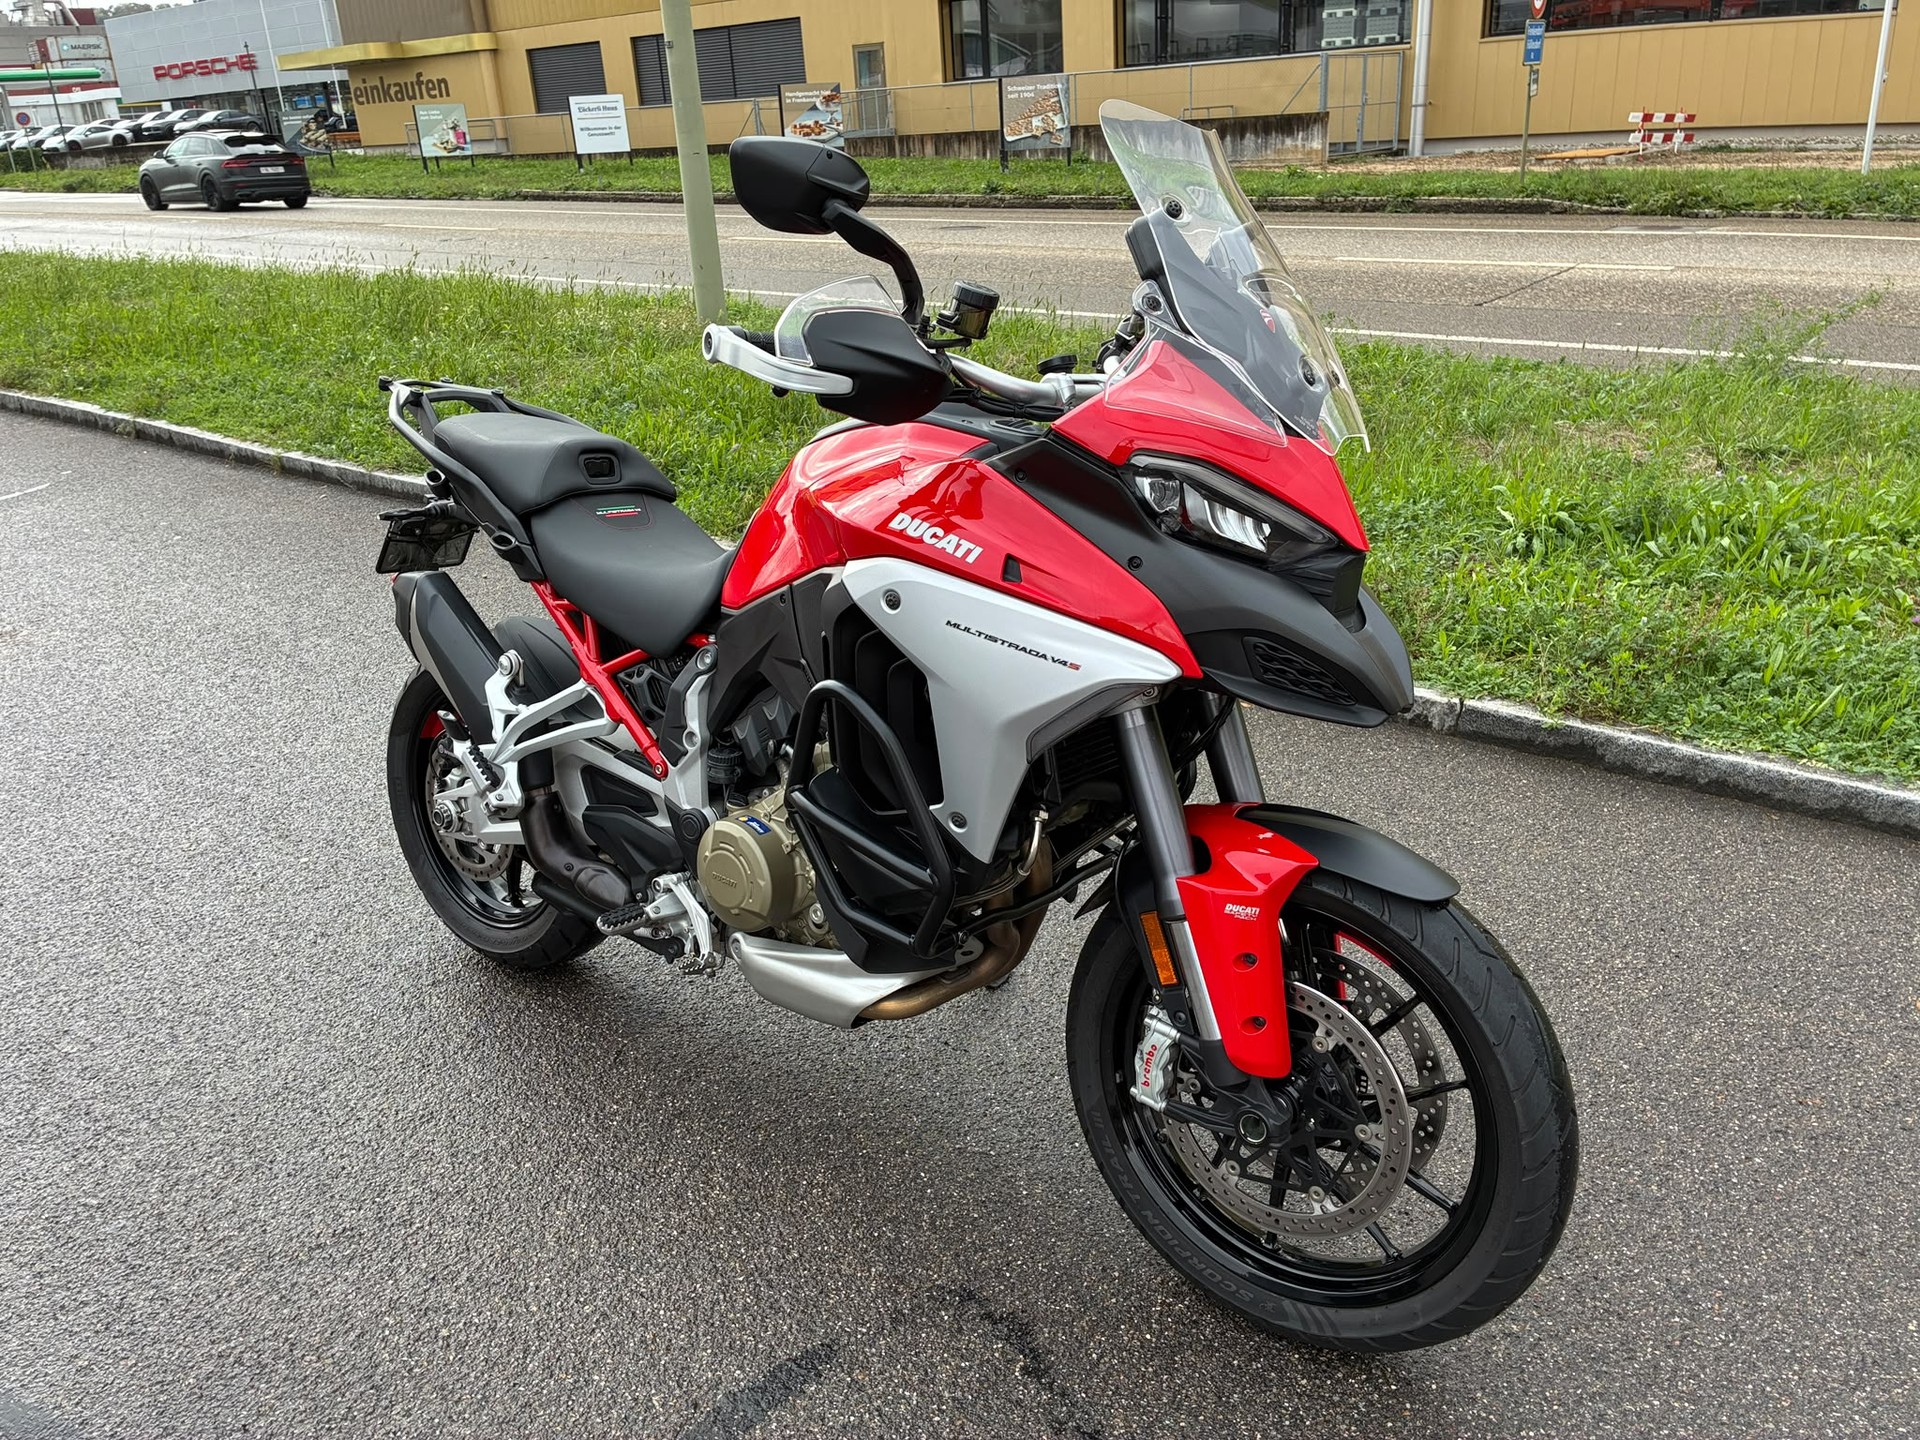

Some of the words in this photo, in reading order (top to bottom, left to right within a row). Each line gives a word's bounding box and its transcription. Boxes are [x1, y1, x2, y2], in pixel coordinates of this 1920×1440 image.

[153, 53, 257, 81] PORSCHE
[353, 71, 451, 106] einkaufen
[888, 512, 984, 564] DUCATI
[945, 619, 1048, 662] MULTISTRADA
[1050, 654, 1082, 671] V4S
[712, 871, 737, 889] DUCATI
[1225, 903, 1260, 915] DUCATI
[1141, 1044, 1158, 1088] brembo
[1101, 1134, 1141, 1204] TRAIL
[1140, 1210, 1255, 1302] SCORPION
